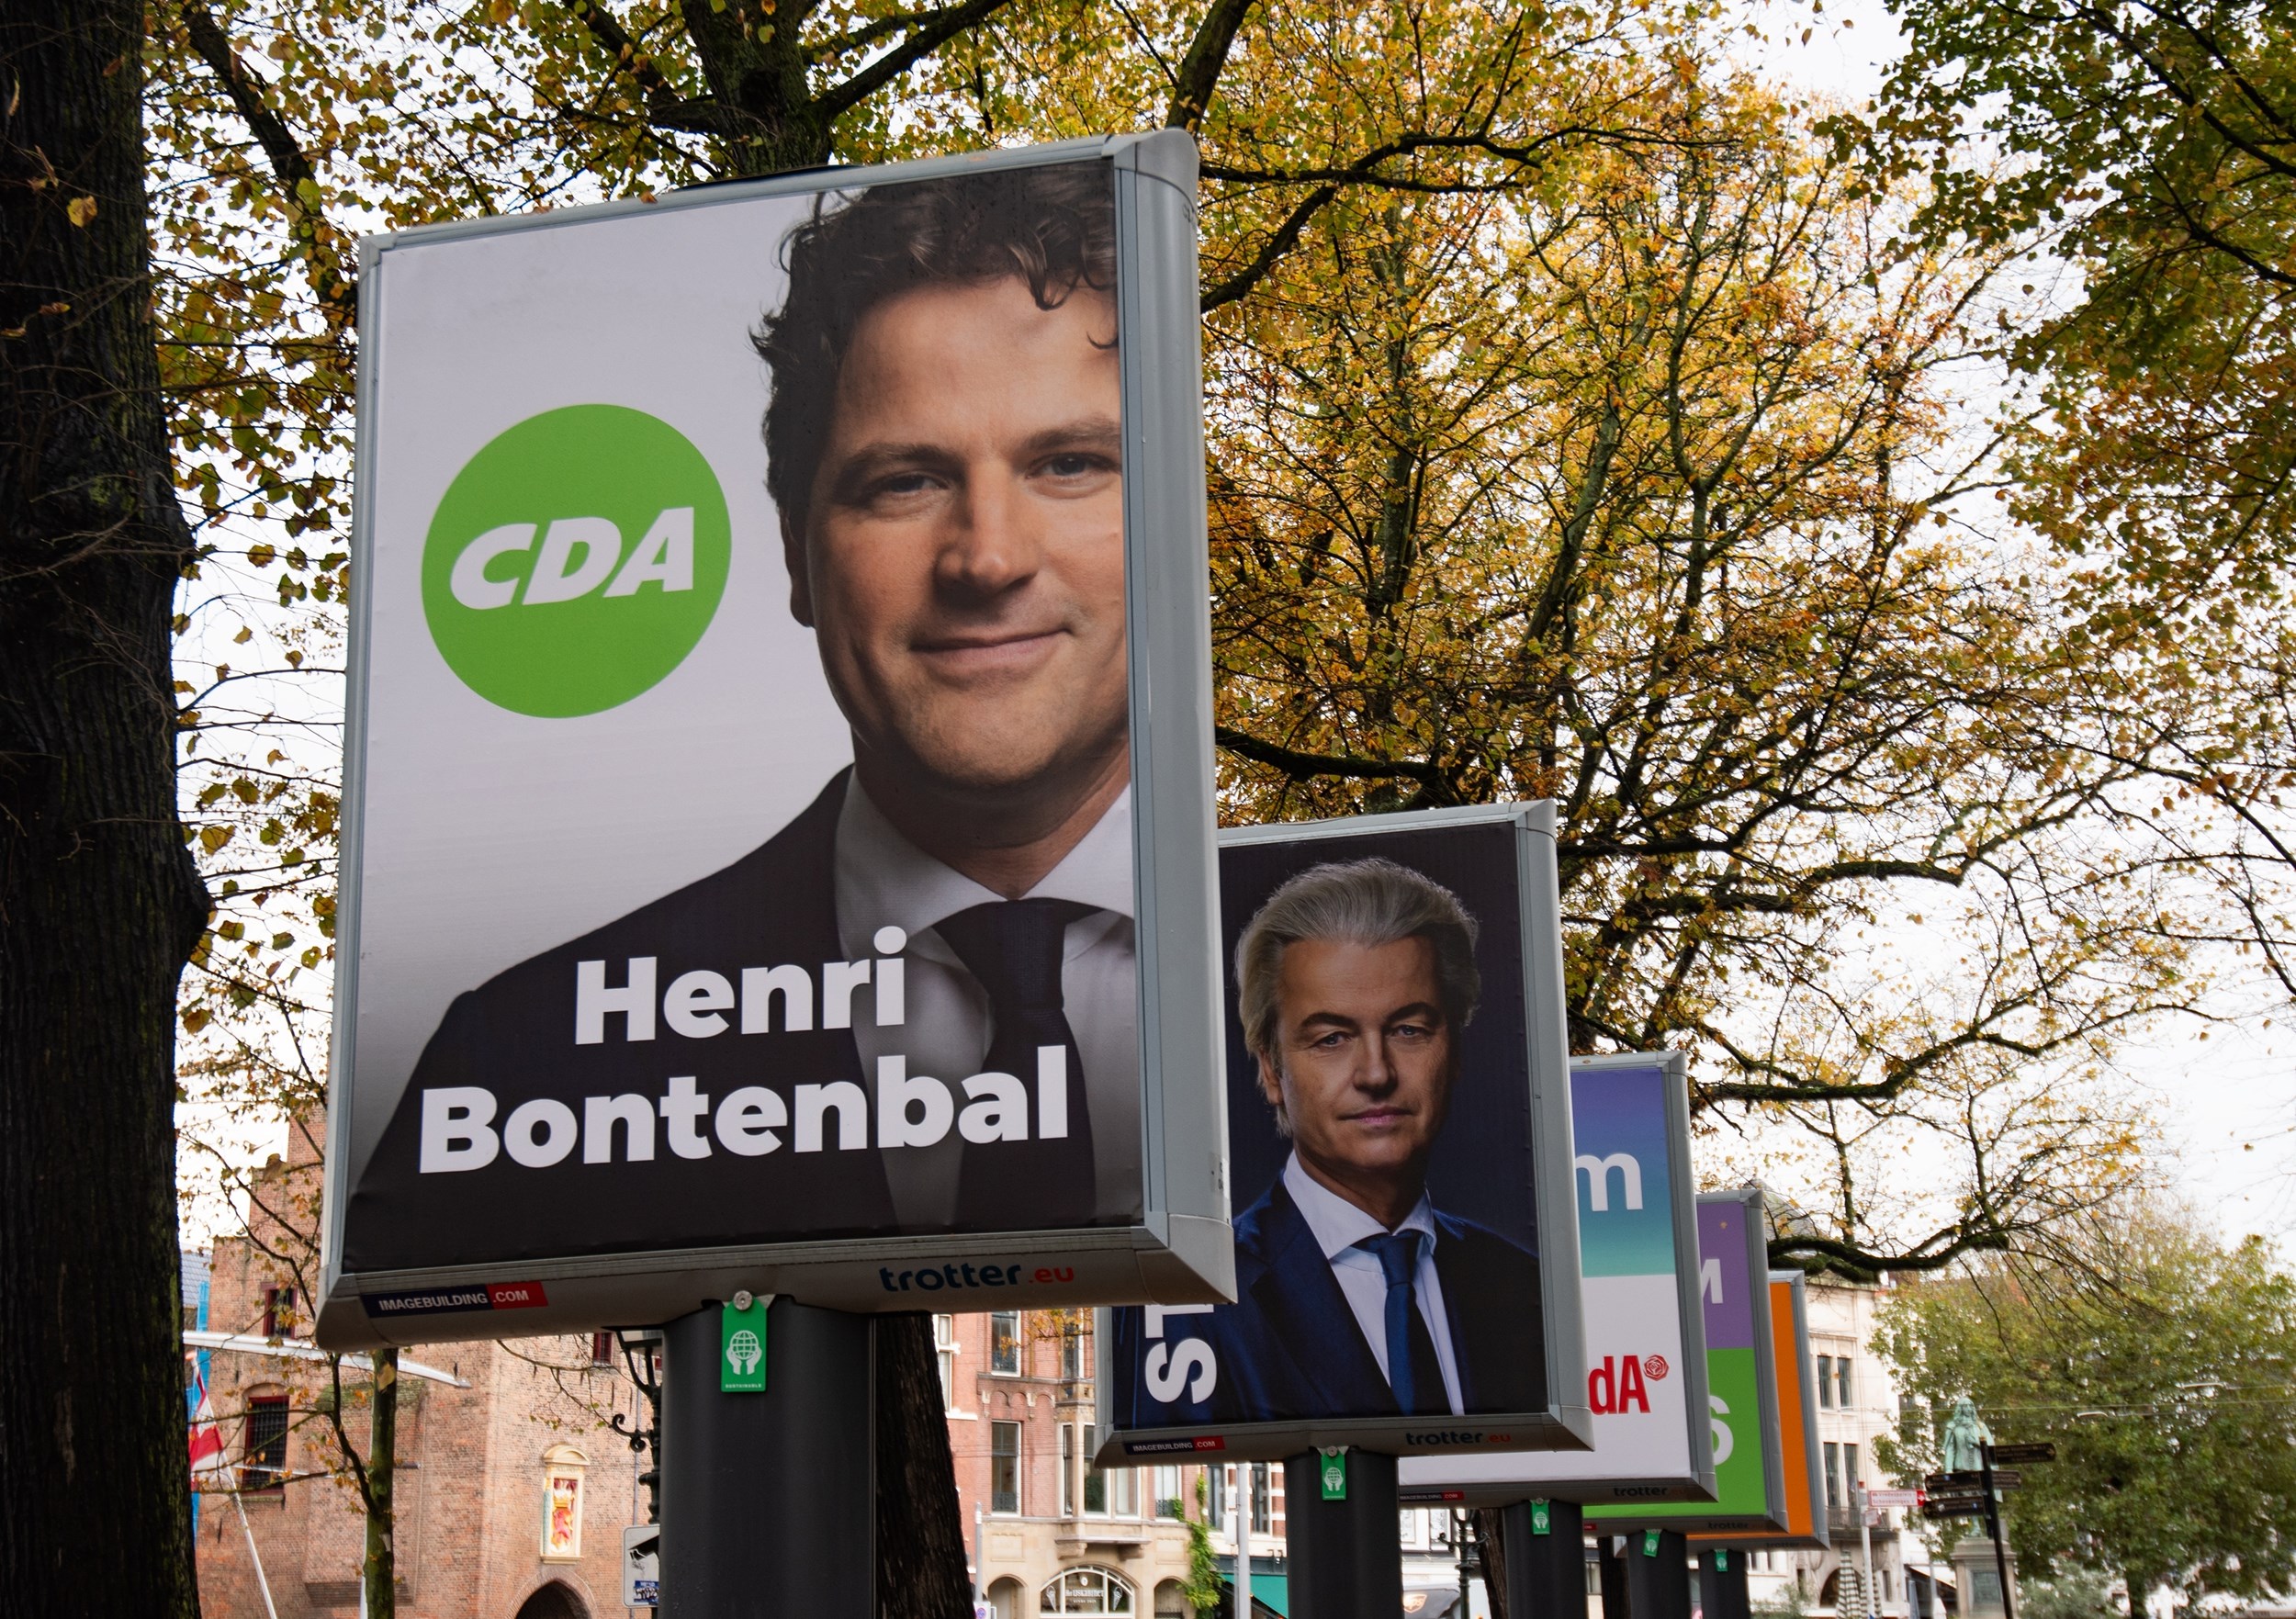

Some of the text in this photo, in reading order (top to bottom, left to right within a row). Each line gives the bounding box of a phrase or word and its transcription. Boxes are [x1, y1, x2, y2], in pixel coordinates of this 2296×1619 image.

[450, 506, 694, 610] CDA
[575, 926, 907, 1045] Henri
[419, 1044, 1069, 1174] Bontenbal
[879, 1263, 1075, 1292] trotter.eu
[378, 1290, 530, 1310] IMAGEBUILDING.COM
[1131, 1440, 1217, 1452] IMAGEBUILDING.COM
[1405, 1432, 1512, 1445] trotter.eu
